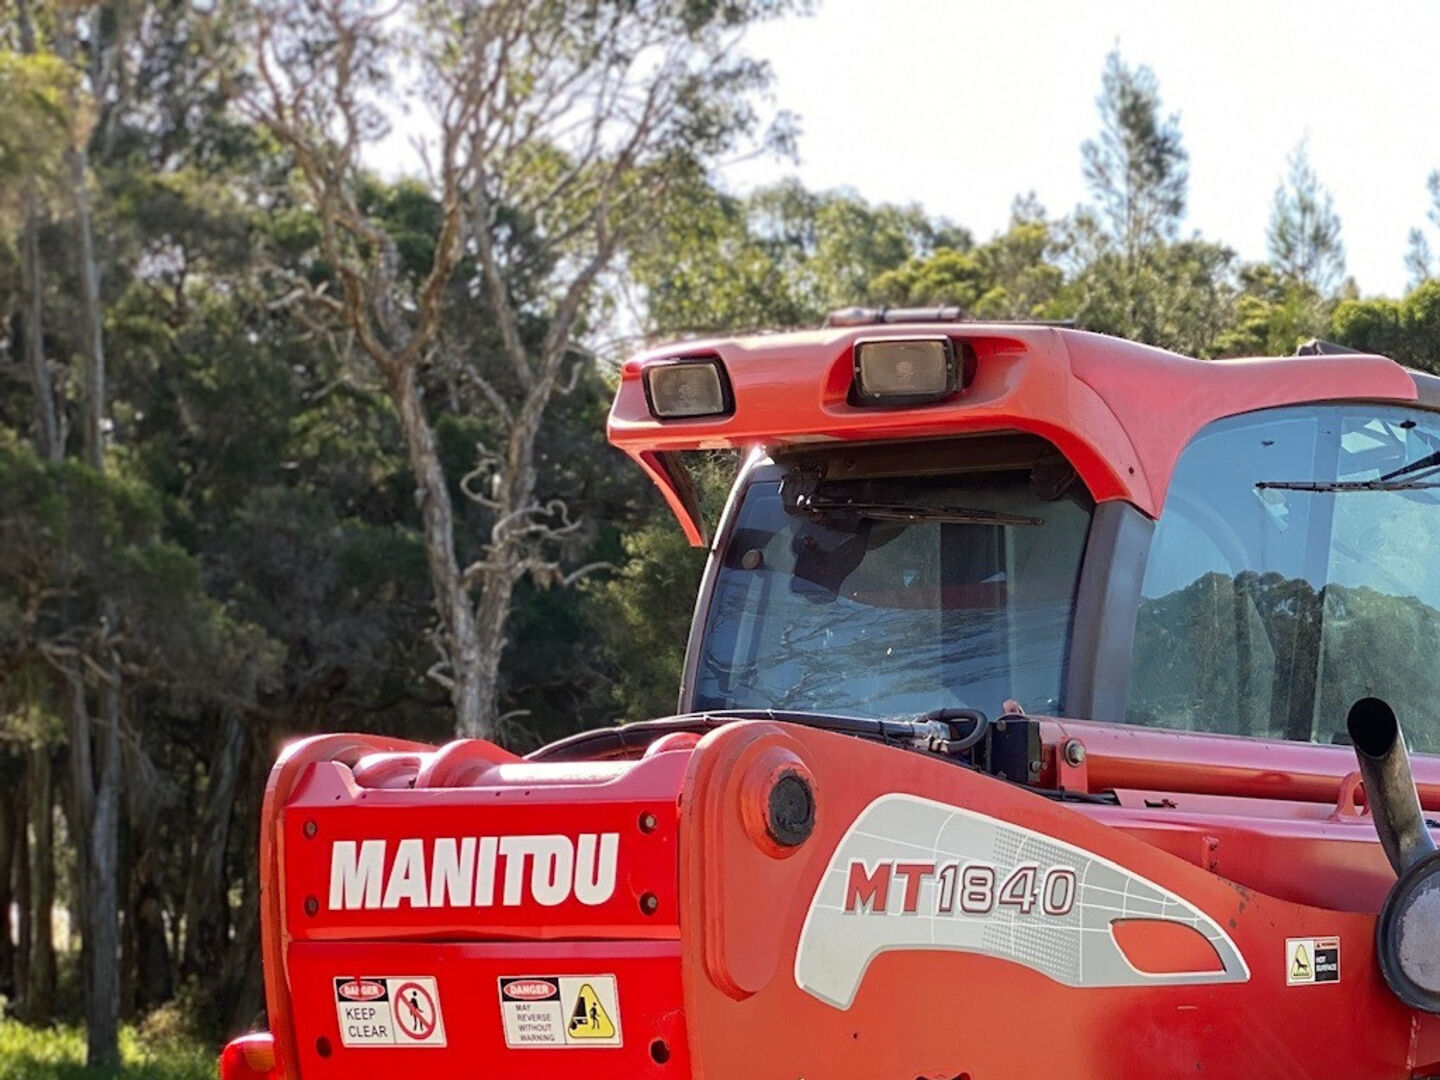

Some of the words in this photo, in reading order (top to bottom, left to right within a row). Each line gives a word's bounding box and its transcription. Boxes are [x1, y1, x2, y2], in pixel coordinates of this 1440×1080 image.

[328, 832, 620, 910] MANITOU
[843, 858, 1078, 916] MT1840
[343, 984, 379, 996] DAGER
[509, 984, 549, 995] DANGER
[515, 1004, 531, 1012] MAY
[345, 1007, 376, 1021] KEEP
[516, 1013, 552, 1023] REVERSE
[348, 1025, 388, 1038] CLEAR
[519, 1023, 552, 1032] WITHOUT
[520, 1033, 555, 1042] WARNING
